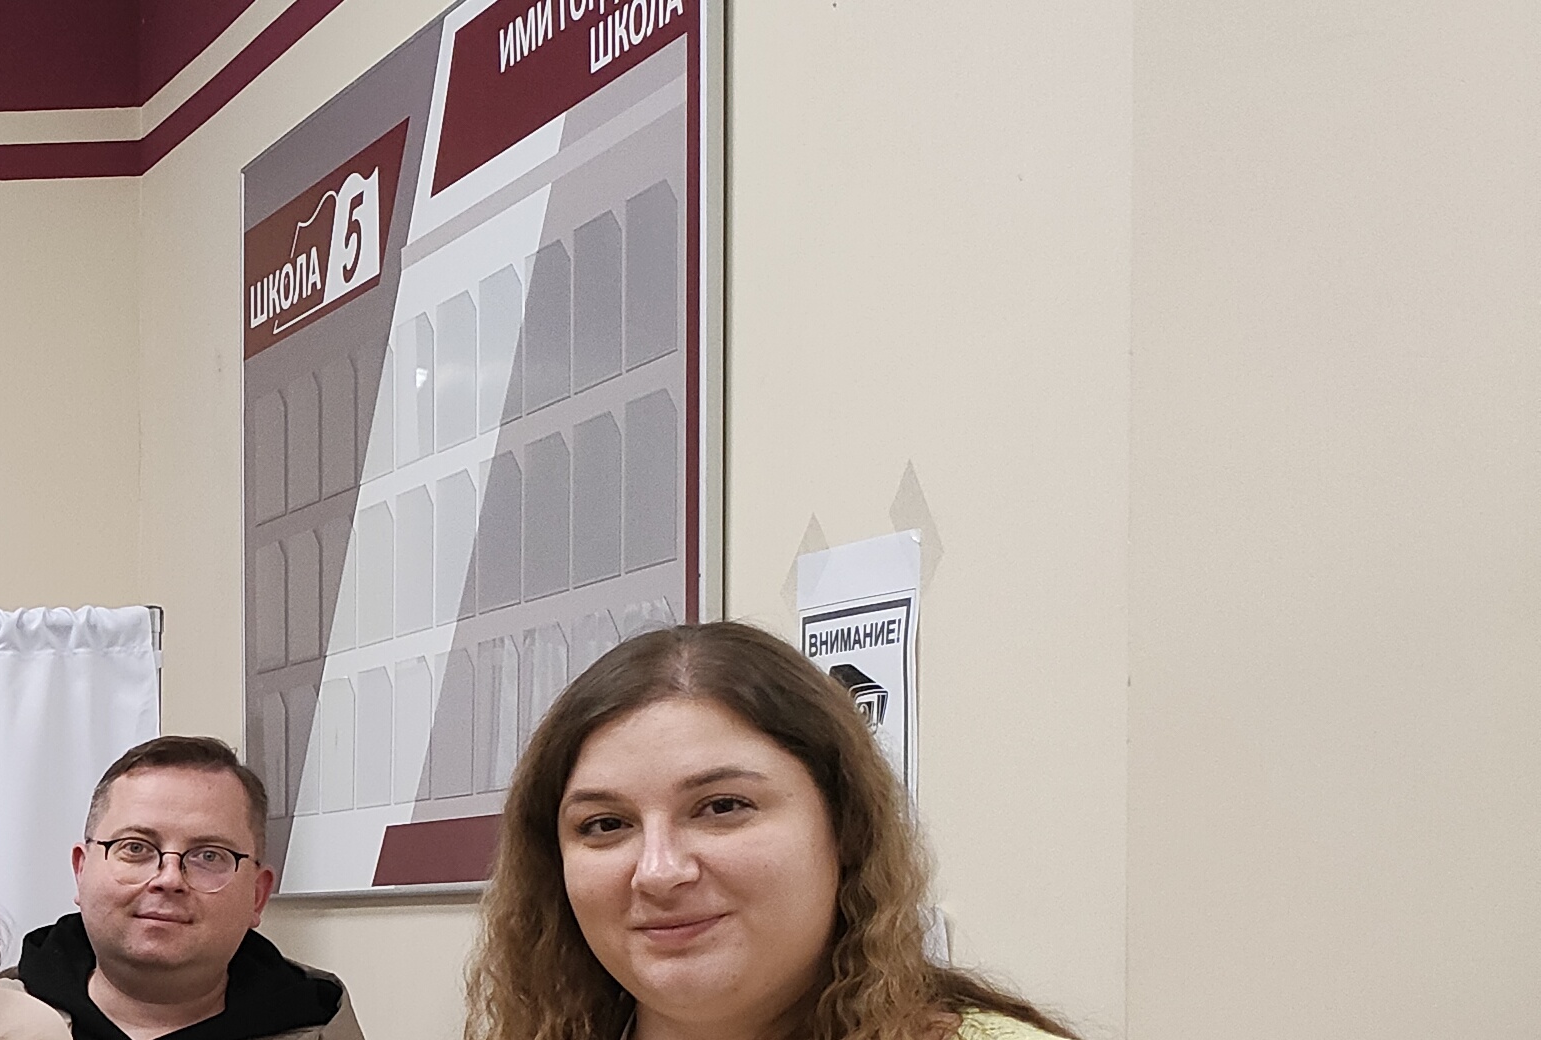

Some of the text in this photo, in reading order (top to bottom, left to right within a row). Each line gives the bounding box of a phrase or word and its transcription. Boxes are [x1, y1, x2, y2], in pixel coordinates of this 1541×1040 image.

[250, 190, 365, 329] ШКОЛА 5
[808, 617, 902, 658] ВНИМАНИЕ!
